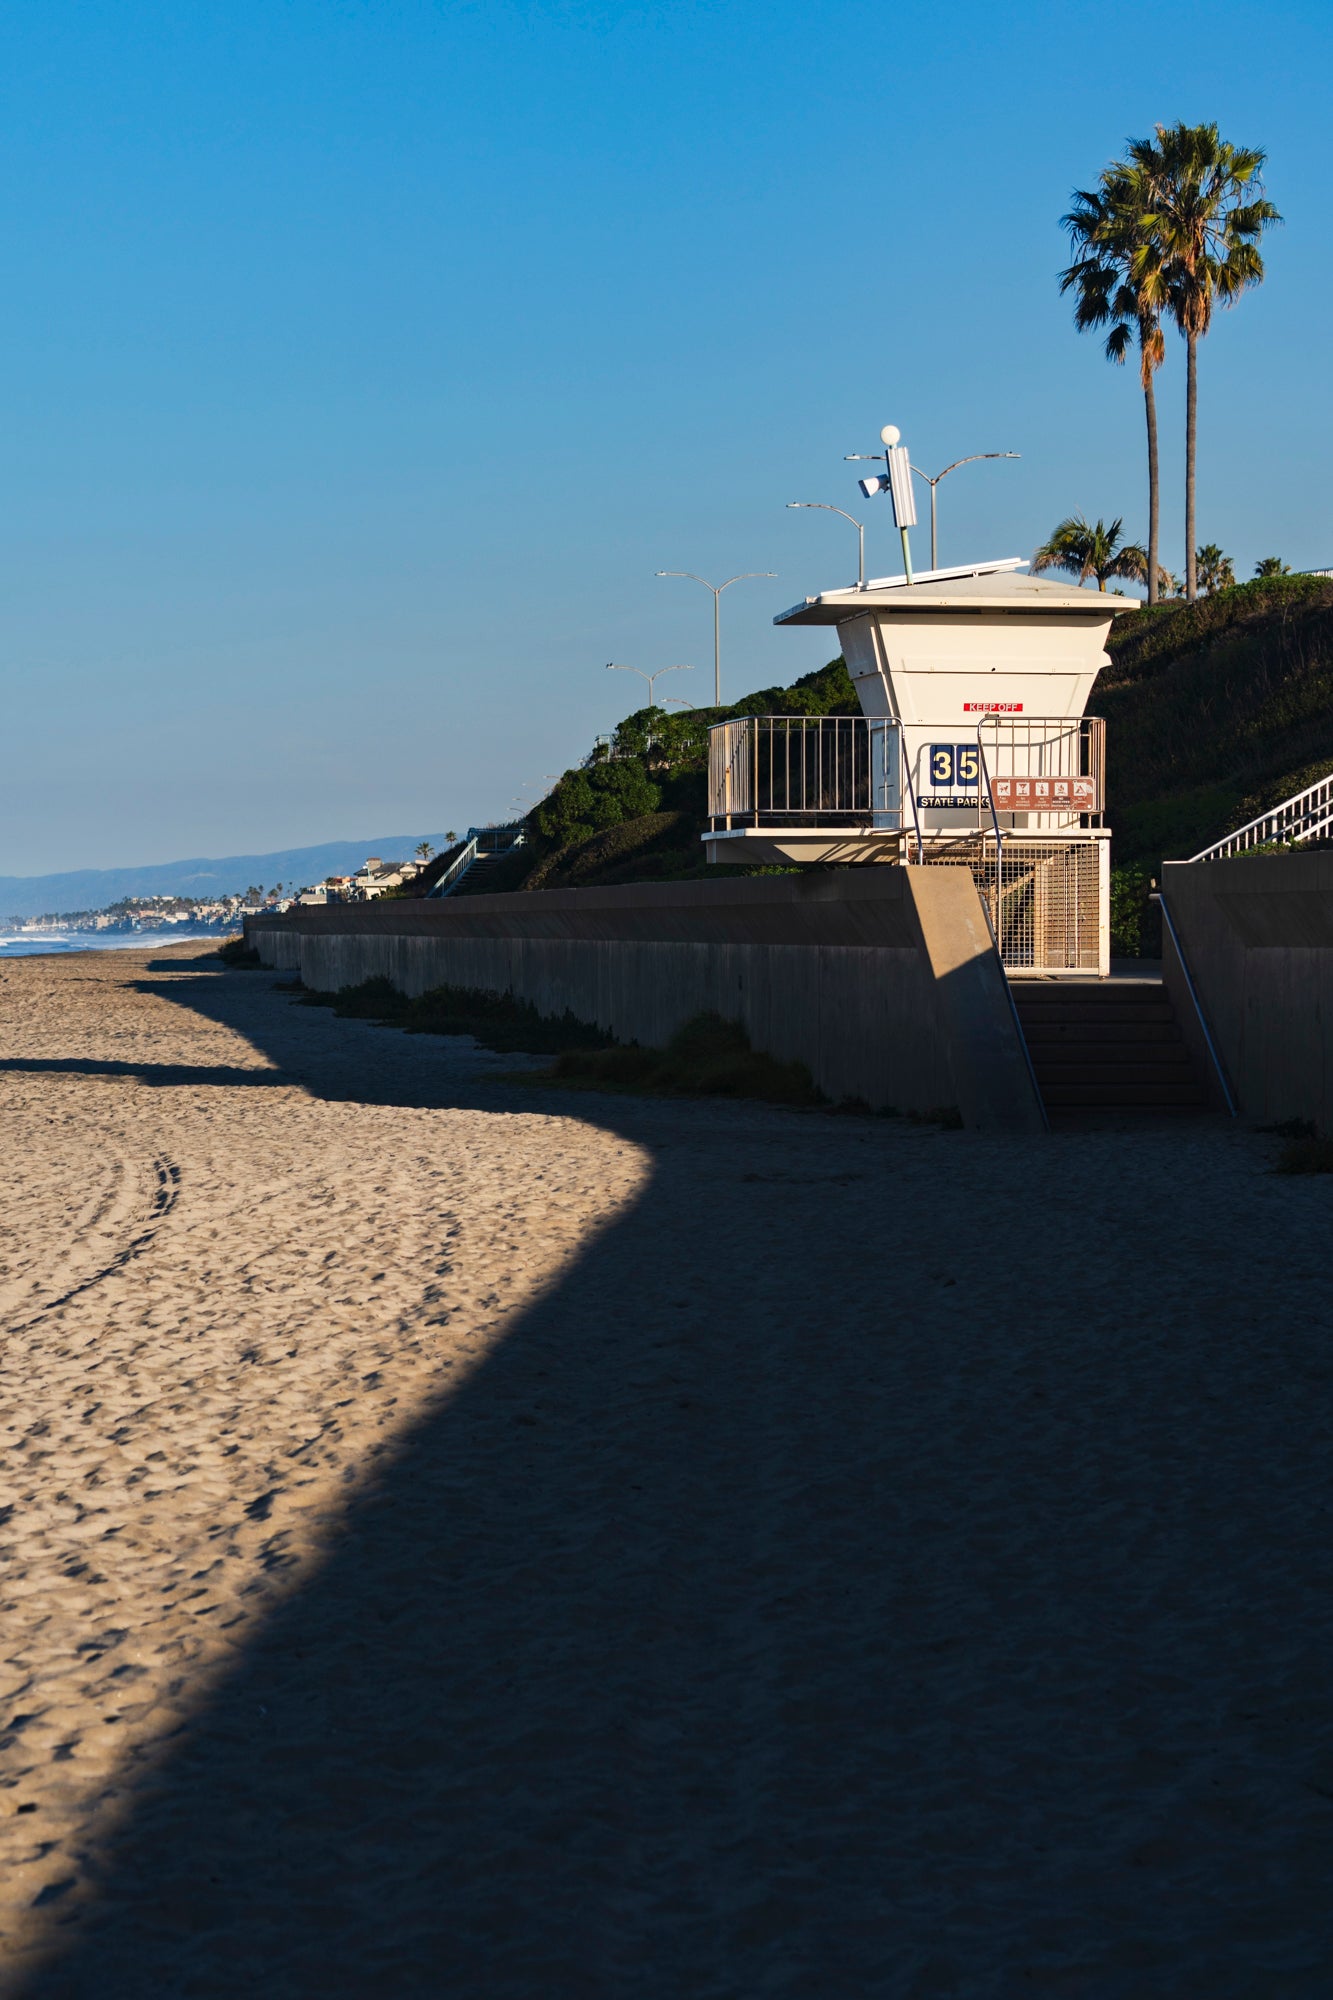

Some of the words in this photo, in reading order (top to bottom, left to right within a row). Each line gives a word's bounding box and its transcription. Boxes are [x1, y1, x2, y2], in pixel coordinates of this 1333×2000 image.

[969, 703, 995, 711] KEEP
[998, 703, 1018, 711] OFF
[933, 751, 978, 780] 35
[921, 797, 954, 807] STATE
